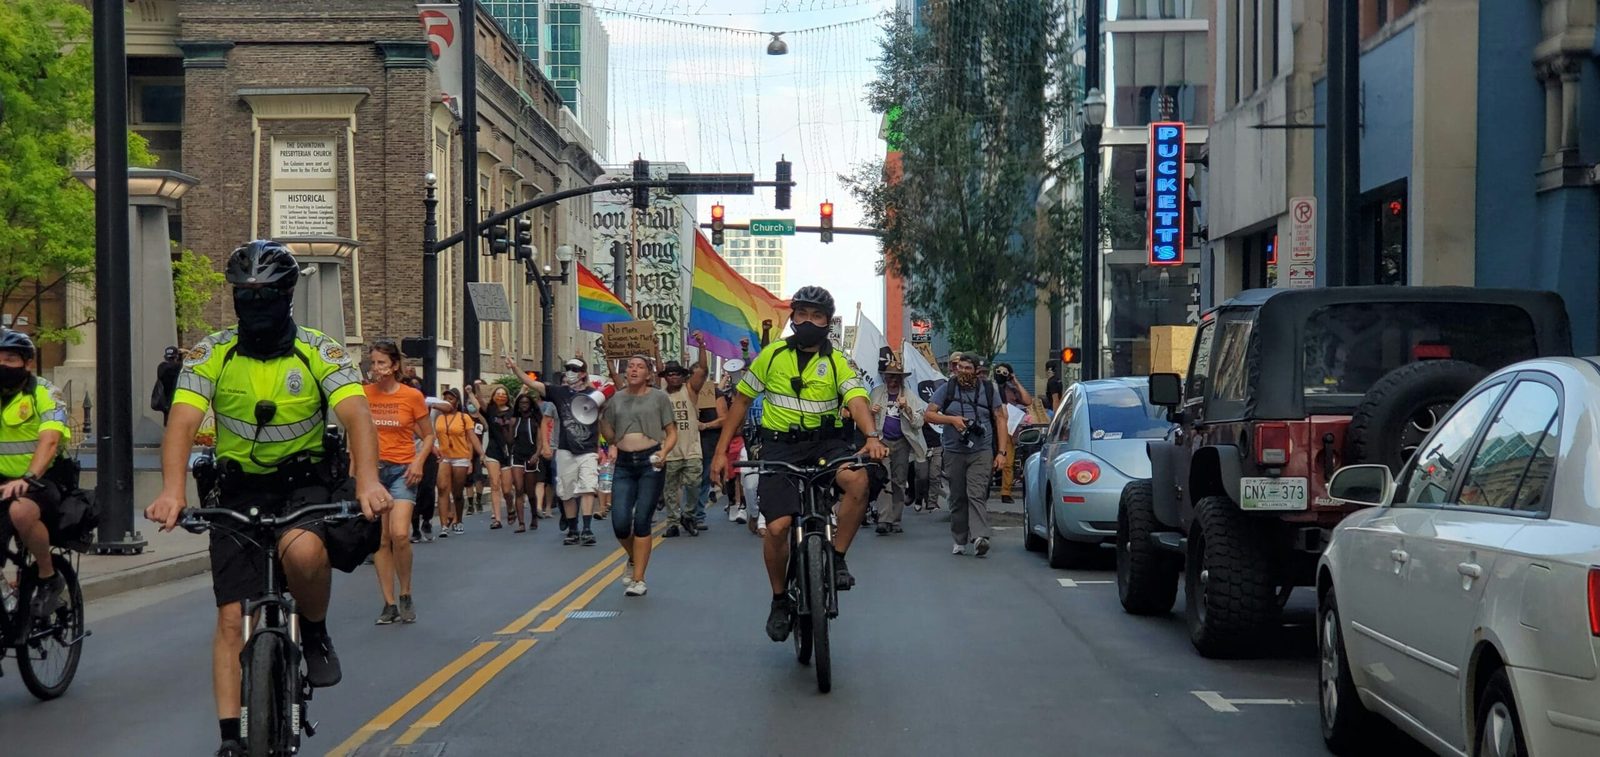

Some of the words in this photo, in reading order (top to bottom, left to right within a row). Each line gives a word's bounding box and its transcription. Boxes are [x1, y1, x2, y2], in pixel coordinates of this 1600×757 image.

[288, 194, 326, 203] HISTORICAL
[1155, 127, 1179, 260] PUCKETT'S
[752, 223, 784, 232] Church
[635, 239, 677, 264] long
[635, 300, 677, 326] long
[1244, 485, 1267, 500] CNX
[1282, 485, 1304, 500] 373
